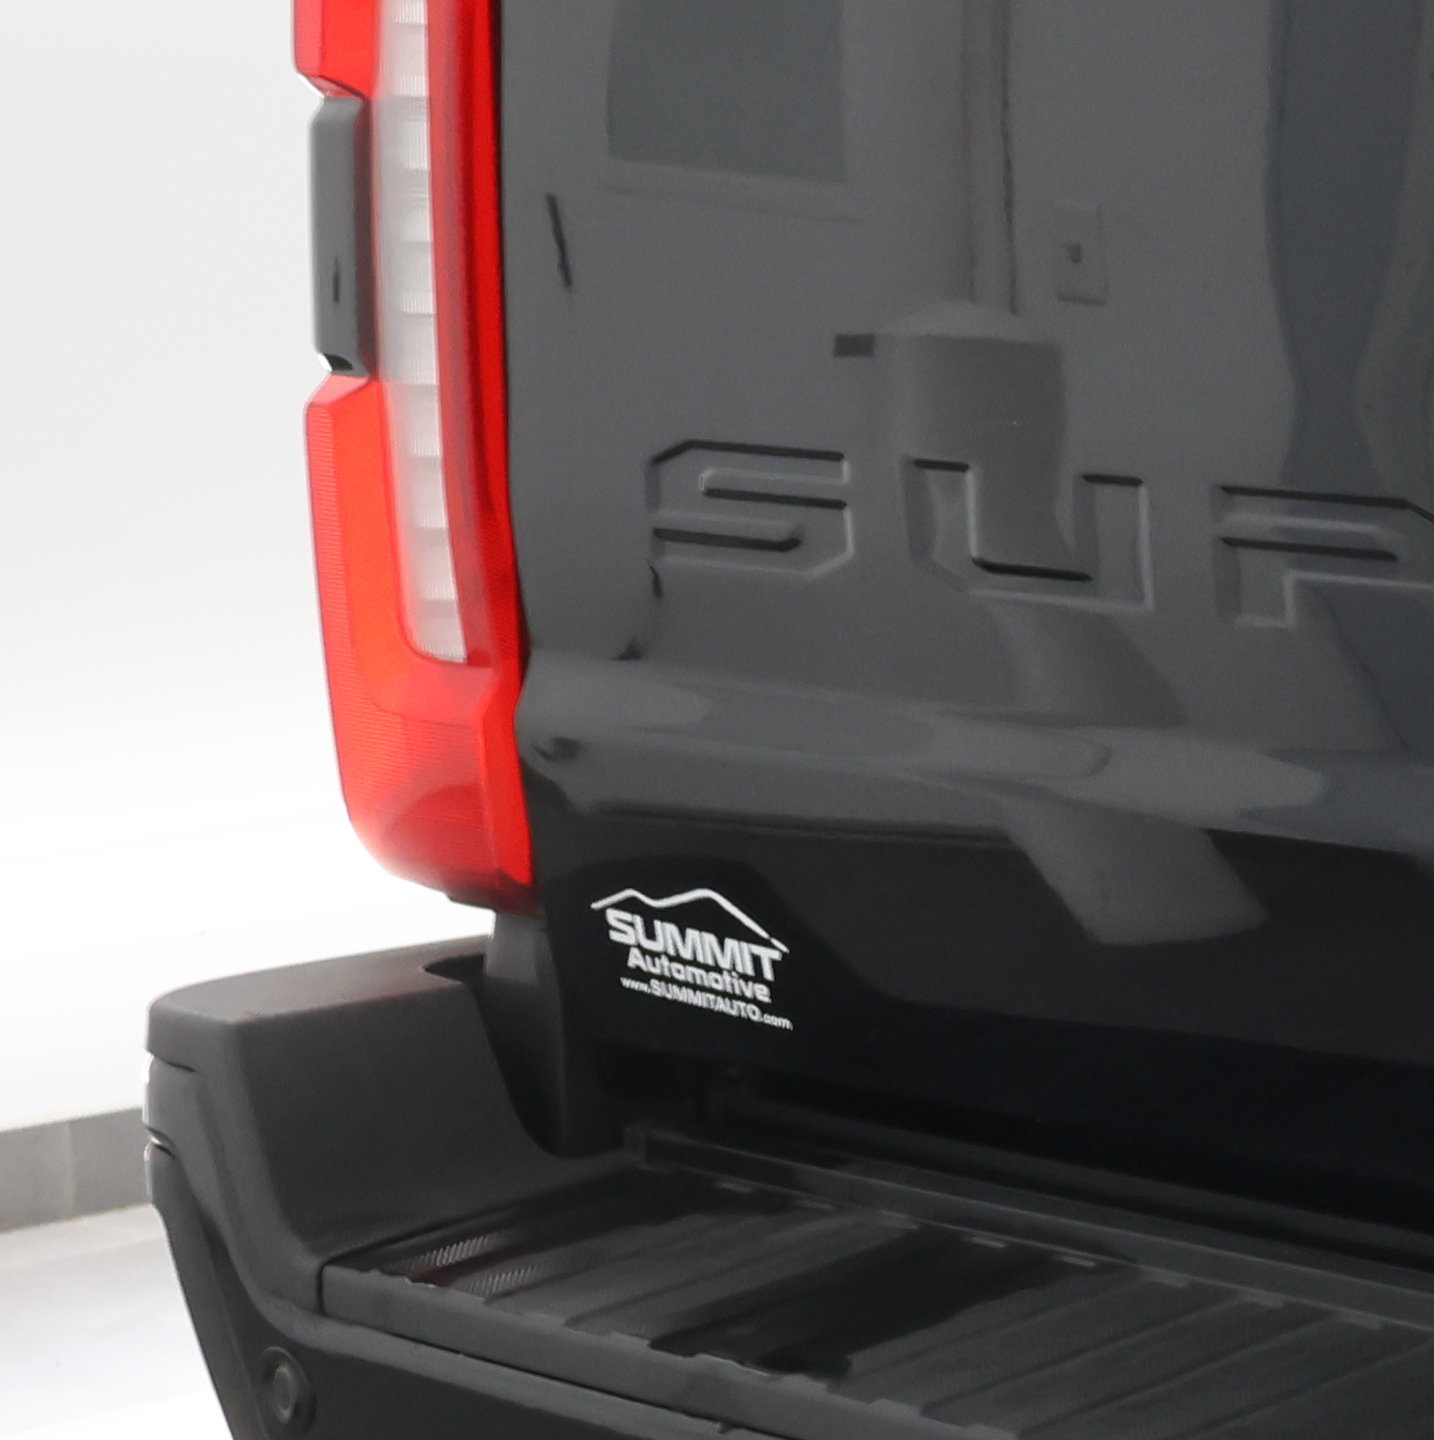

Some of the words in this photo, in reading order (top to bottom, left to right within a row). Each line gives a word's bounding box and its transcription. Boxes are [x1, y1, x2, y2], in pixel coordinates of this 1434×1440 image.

[605, 907, 783, 983] SUMMIT
[620, 976, 793, 1031] www.SUMMITAUTO.com
[626, 946, 772, 1004] Automotive
